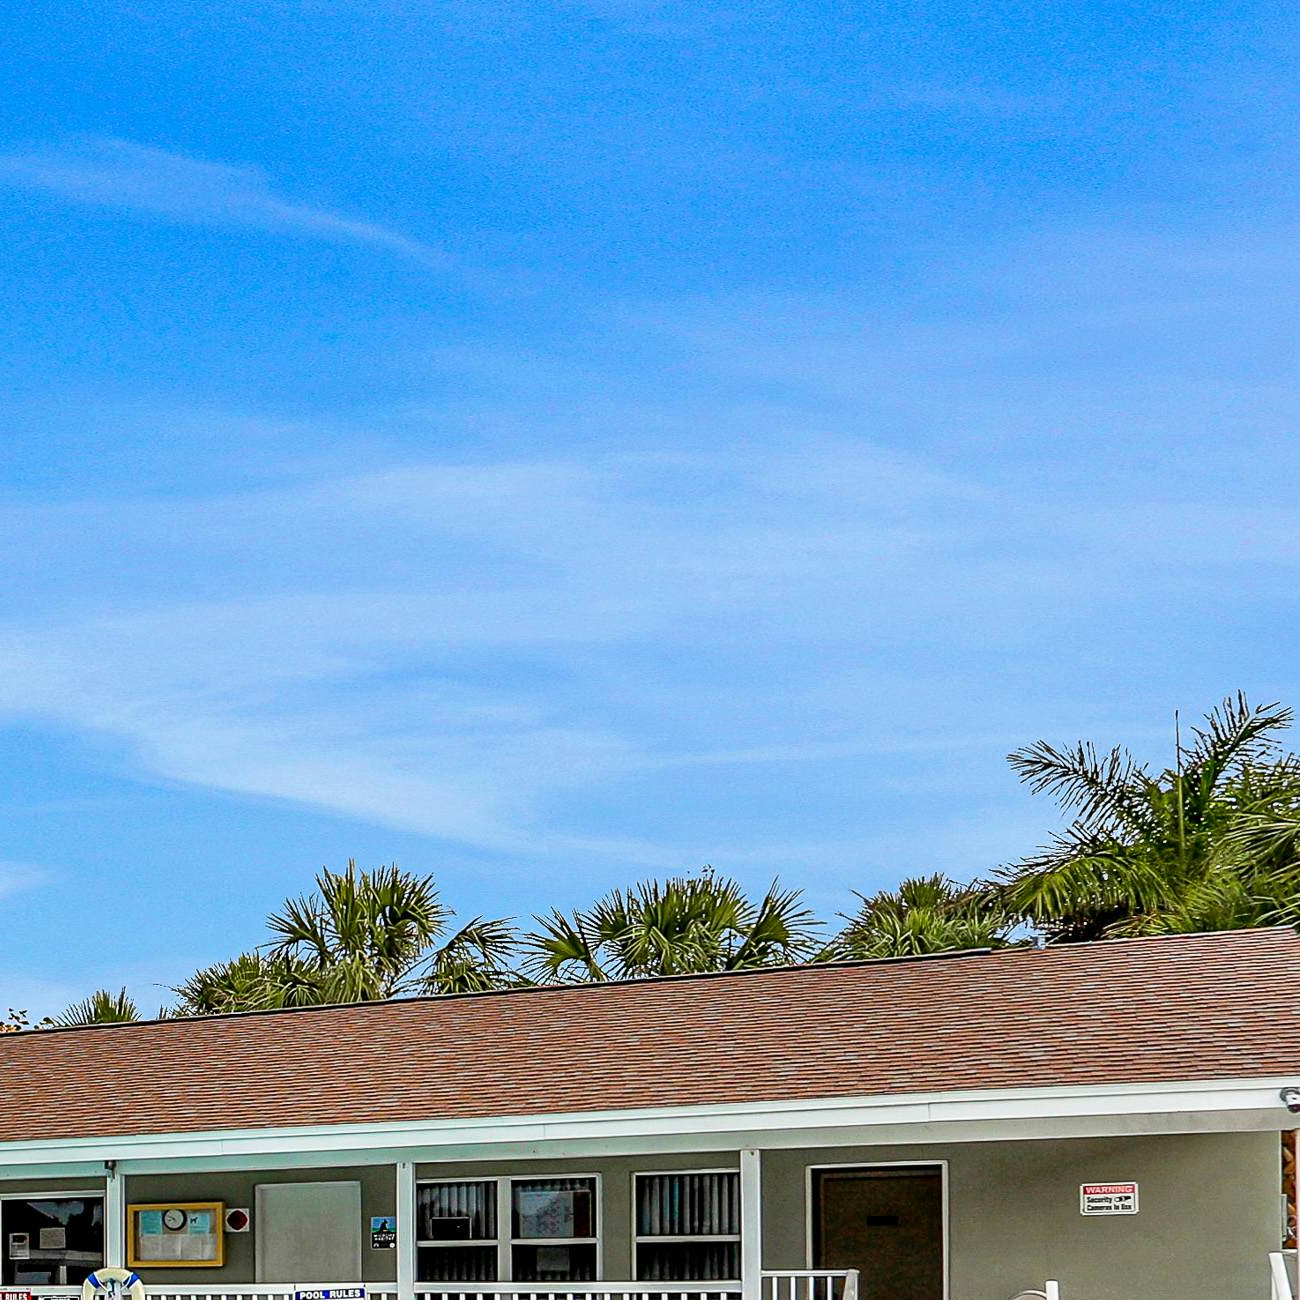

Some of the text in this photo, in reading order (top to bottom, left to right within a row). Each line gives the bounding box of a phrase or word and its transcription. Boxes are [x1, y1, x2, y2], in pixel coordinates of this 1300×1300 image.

[1085, 1186, 1134, 1194] WARNING
[300, 1289, 361, 1300] POOL RULES
